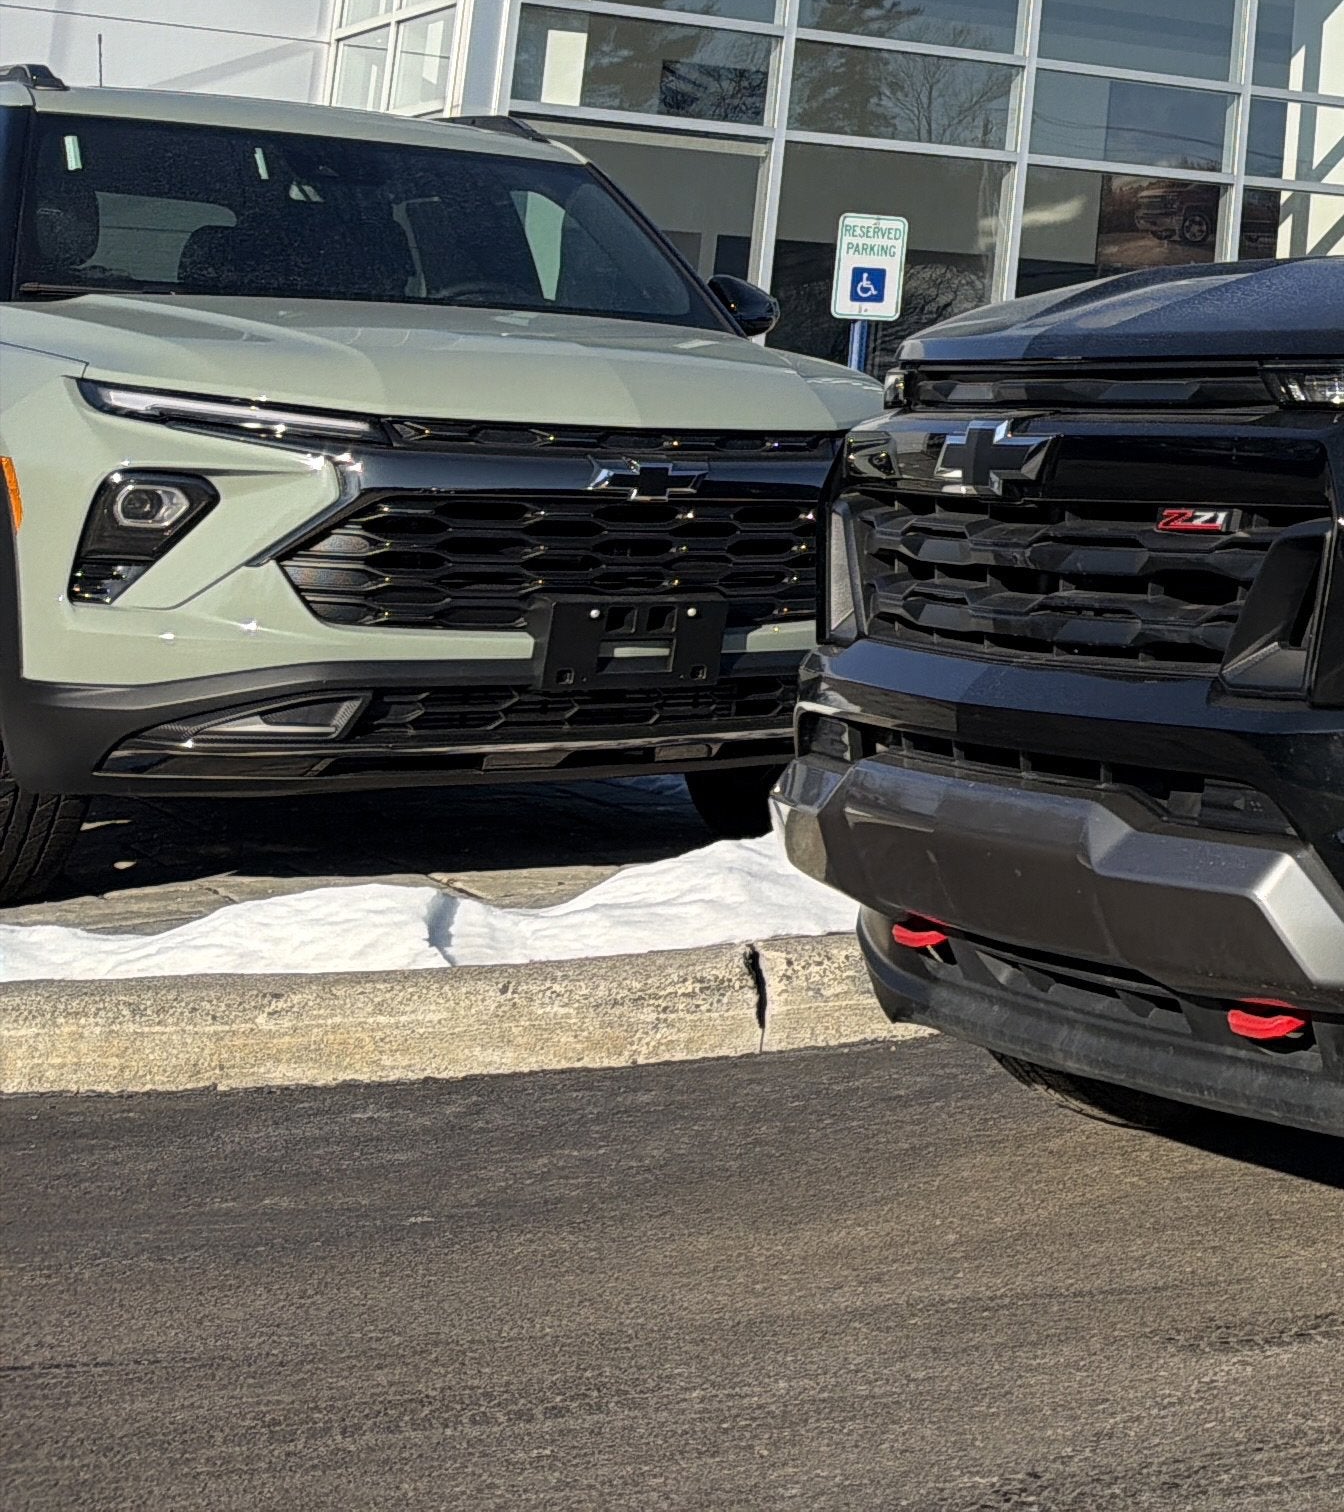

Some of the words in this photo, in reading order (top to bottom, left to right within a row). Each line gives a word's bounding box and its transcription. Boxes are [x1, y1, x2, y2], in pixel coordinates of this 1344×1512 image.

[844, 224, 902, 241] RESERVED
[846, 242, 896, 258] PARKING
[1157, 509, 1229, 531] Z71
